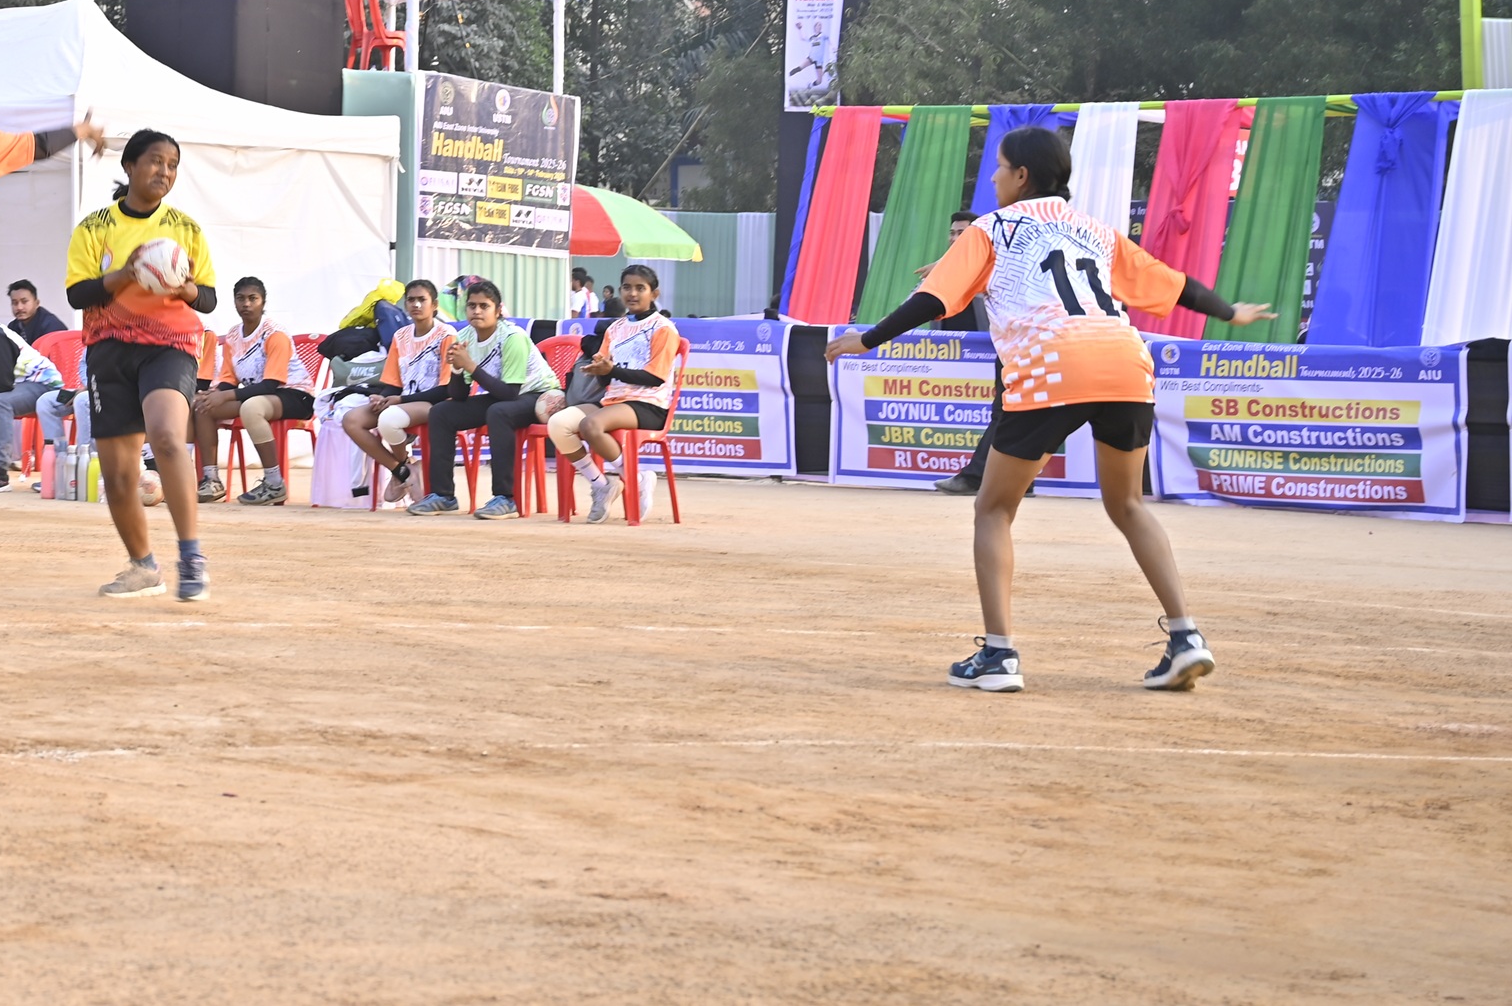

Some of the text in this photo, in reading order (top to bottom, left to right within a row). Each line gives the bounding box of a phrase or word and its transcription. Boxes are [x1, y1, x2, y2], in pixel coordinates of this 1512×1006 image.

[431, 131, 504, 162] Handball
[1010, 221, 1060, 255] UNIVERITY
[1039, 249, 1121, 318] 11
[931, 329, 968, 340] University
[711, 339, 746, 352] 2025-26
[755, 343, 772, 353] AIU
[876, 338, 961, 360] Handball
[1201, 342, 1309, 355] East Zone Inter University
[350, 366, 377, 377] NIKE
[842, 361, 860, 372] With
[861, 361, 878, 372] Best
[1159, 366, 1180, 375] USTM
[1200, 353, 1298, 378] Handball
[1357, 366, 1403, 380] 2025-26
[1418, 369, 1442, 381] AIU
[674, 370, 741, 387] tructions
[1160, 380, 1180, 391] With
[1181, 380, 1201, 392] Best
[883, 379, 996, 398] MH Construc
[676, 393, 743, 411] ructions
[1211, 398, 1401, 420] SB Constructions
[878, 402, 940, 421] JOYNUL
[670, 416, 743, 434] tructions
[881, 426, 915, 444] JBR
[1210, 424, 1405, 446] AM Constructions
[638, 439, 745, 457] ontructions
[894, 451, 912, 468] RI
[1208, 449, 1405, 474] SUNRISE Constructions
[1211, 474, 1408, 500] PRIME Constructions
